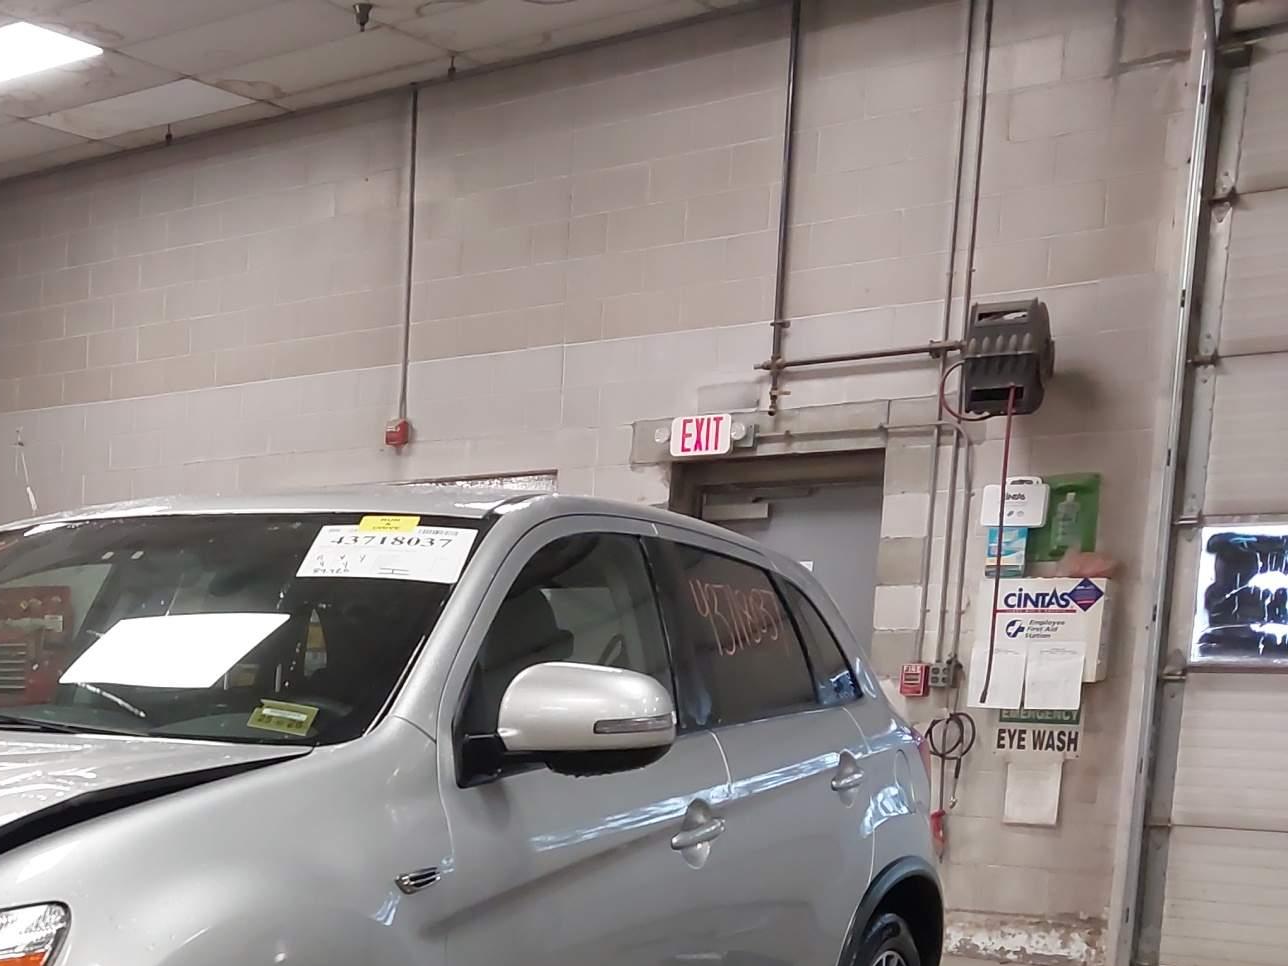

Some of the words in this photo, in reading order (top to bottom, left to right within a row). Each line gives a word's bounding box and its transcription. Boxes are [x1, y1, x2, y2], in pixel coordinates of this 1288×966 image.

[681, 416, 723, 452] EXIT
[330, 535, 453, 549] 43718037
[997, 728, 1027, 750] EYE
[1032, 729, 1079, 752] WASH
